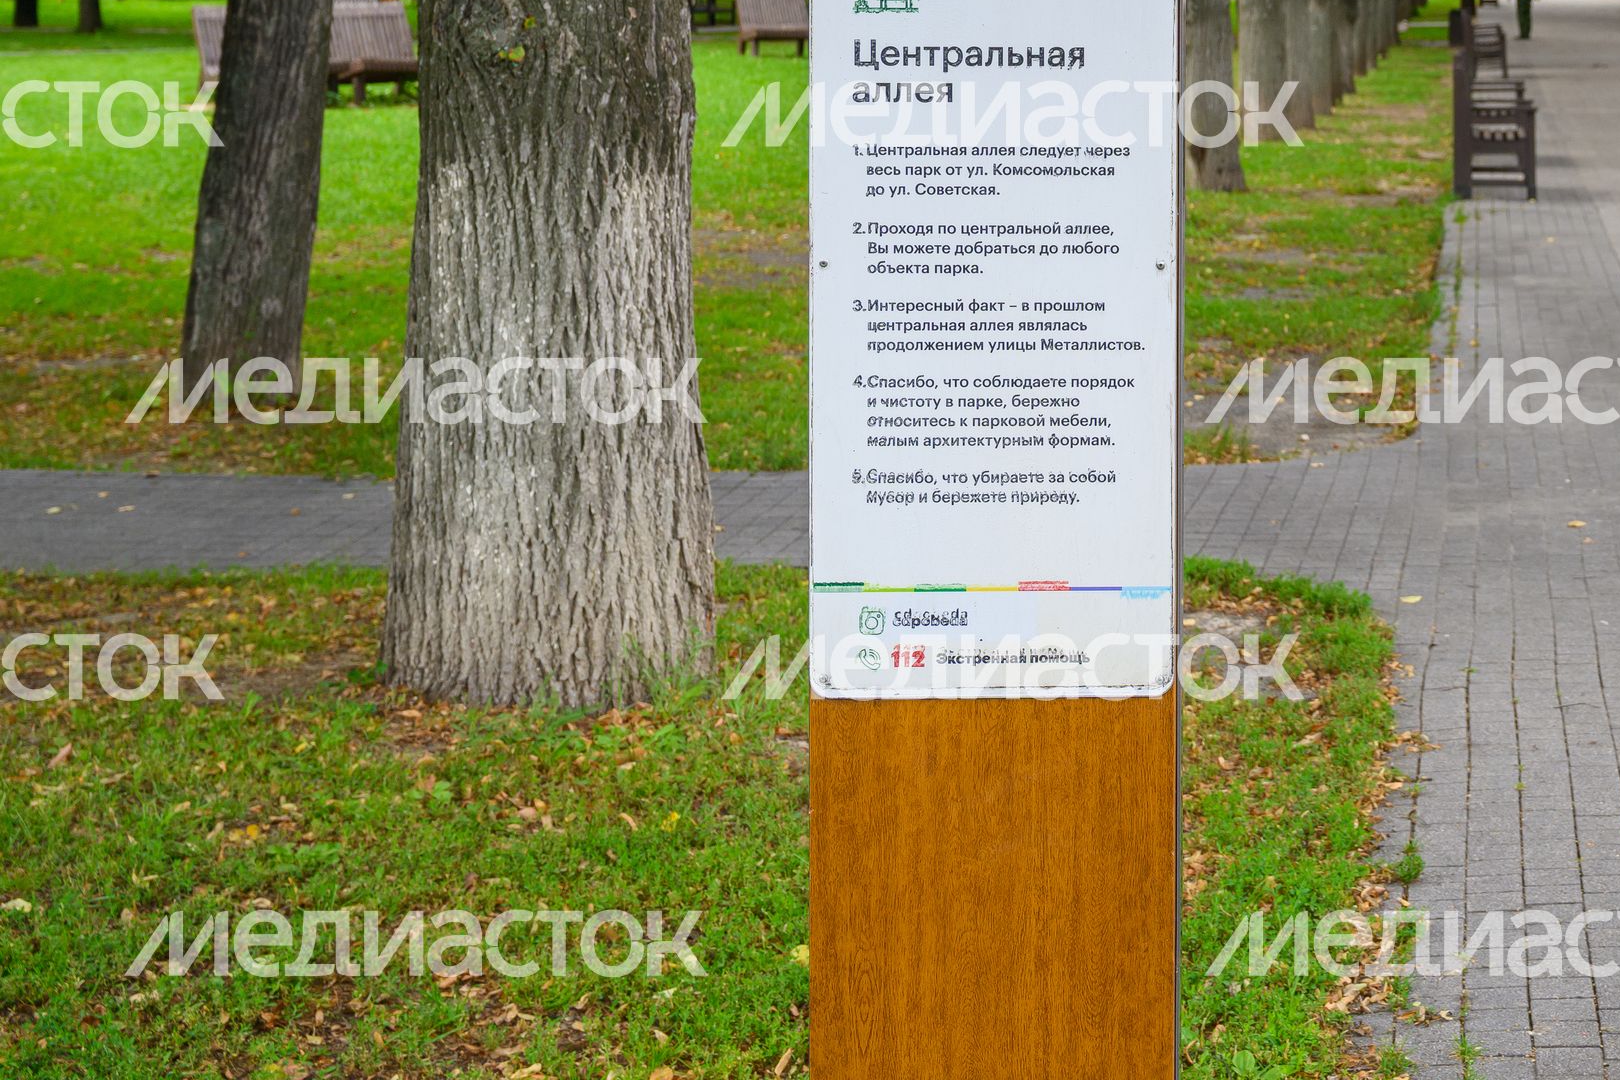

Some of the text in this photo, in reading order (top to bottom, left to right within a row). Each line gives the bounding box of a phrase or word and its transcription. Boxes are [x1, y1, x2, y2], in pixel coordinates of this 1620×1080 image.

[854, 39, 1086, 72] Центральная
[852, 82, 954, 103] аллея
[866, 144, 966, 159] Центральная
[971, 146, 1016, 157] аллея
[1019, 146, 1082, 160] следует
[1084, 146, 1131, 160] через
[866, 162, 1115, 179] весь парк от ул. Комсомольская
[865, 182, 1001, 199] до ул. Советская.
[937, 224, 957, 235] по
[960, 221, 1062, 238] центральной
[1063, 224, 1114, 238] аллее,
[867, 240, 1120, 257] Вы можете добраться до любого
[866, 260, 984, 277] объекта парка.
[968, 298, 1006, 315] факт
[1021, 301, 1030, 312] в
[1033, 301, 1106, 315] прошлом
[867, 321, 1088, 334] центральная аллея являлась
[867, 338, 1146, 354] продолжением улицы Металлистов.
[943, 378, 970, 388] что
[972, 374, 1067, 390] соблюдаете
[1070, 377, 1135, 391] порядок
[866, 394, 1081, 411] и чистоту в парке, бережно
[866, 413, 1112, 430] относитесь к парковой мебели,
[866, 432, 1116, 450] малым архитектурным формам.
[942, 472, 969, 484] что
[971, 470, 1045, 487] убираете
[1048, 472, 1065, 484] за
[1068, 468, 1116, 484] собой
[931, 490, 1008, 506] бережете
[1011, 491, 1081, 506] природу.
[891, 647, 926, 668] 112
